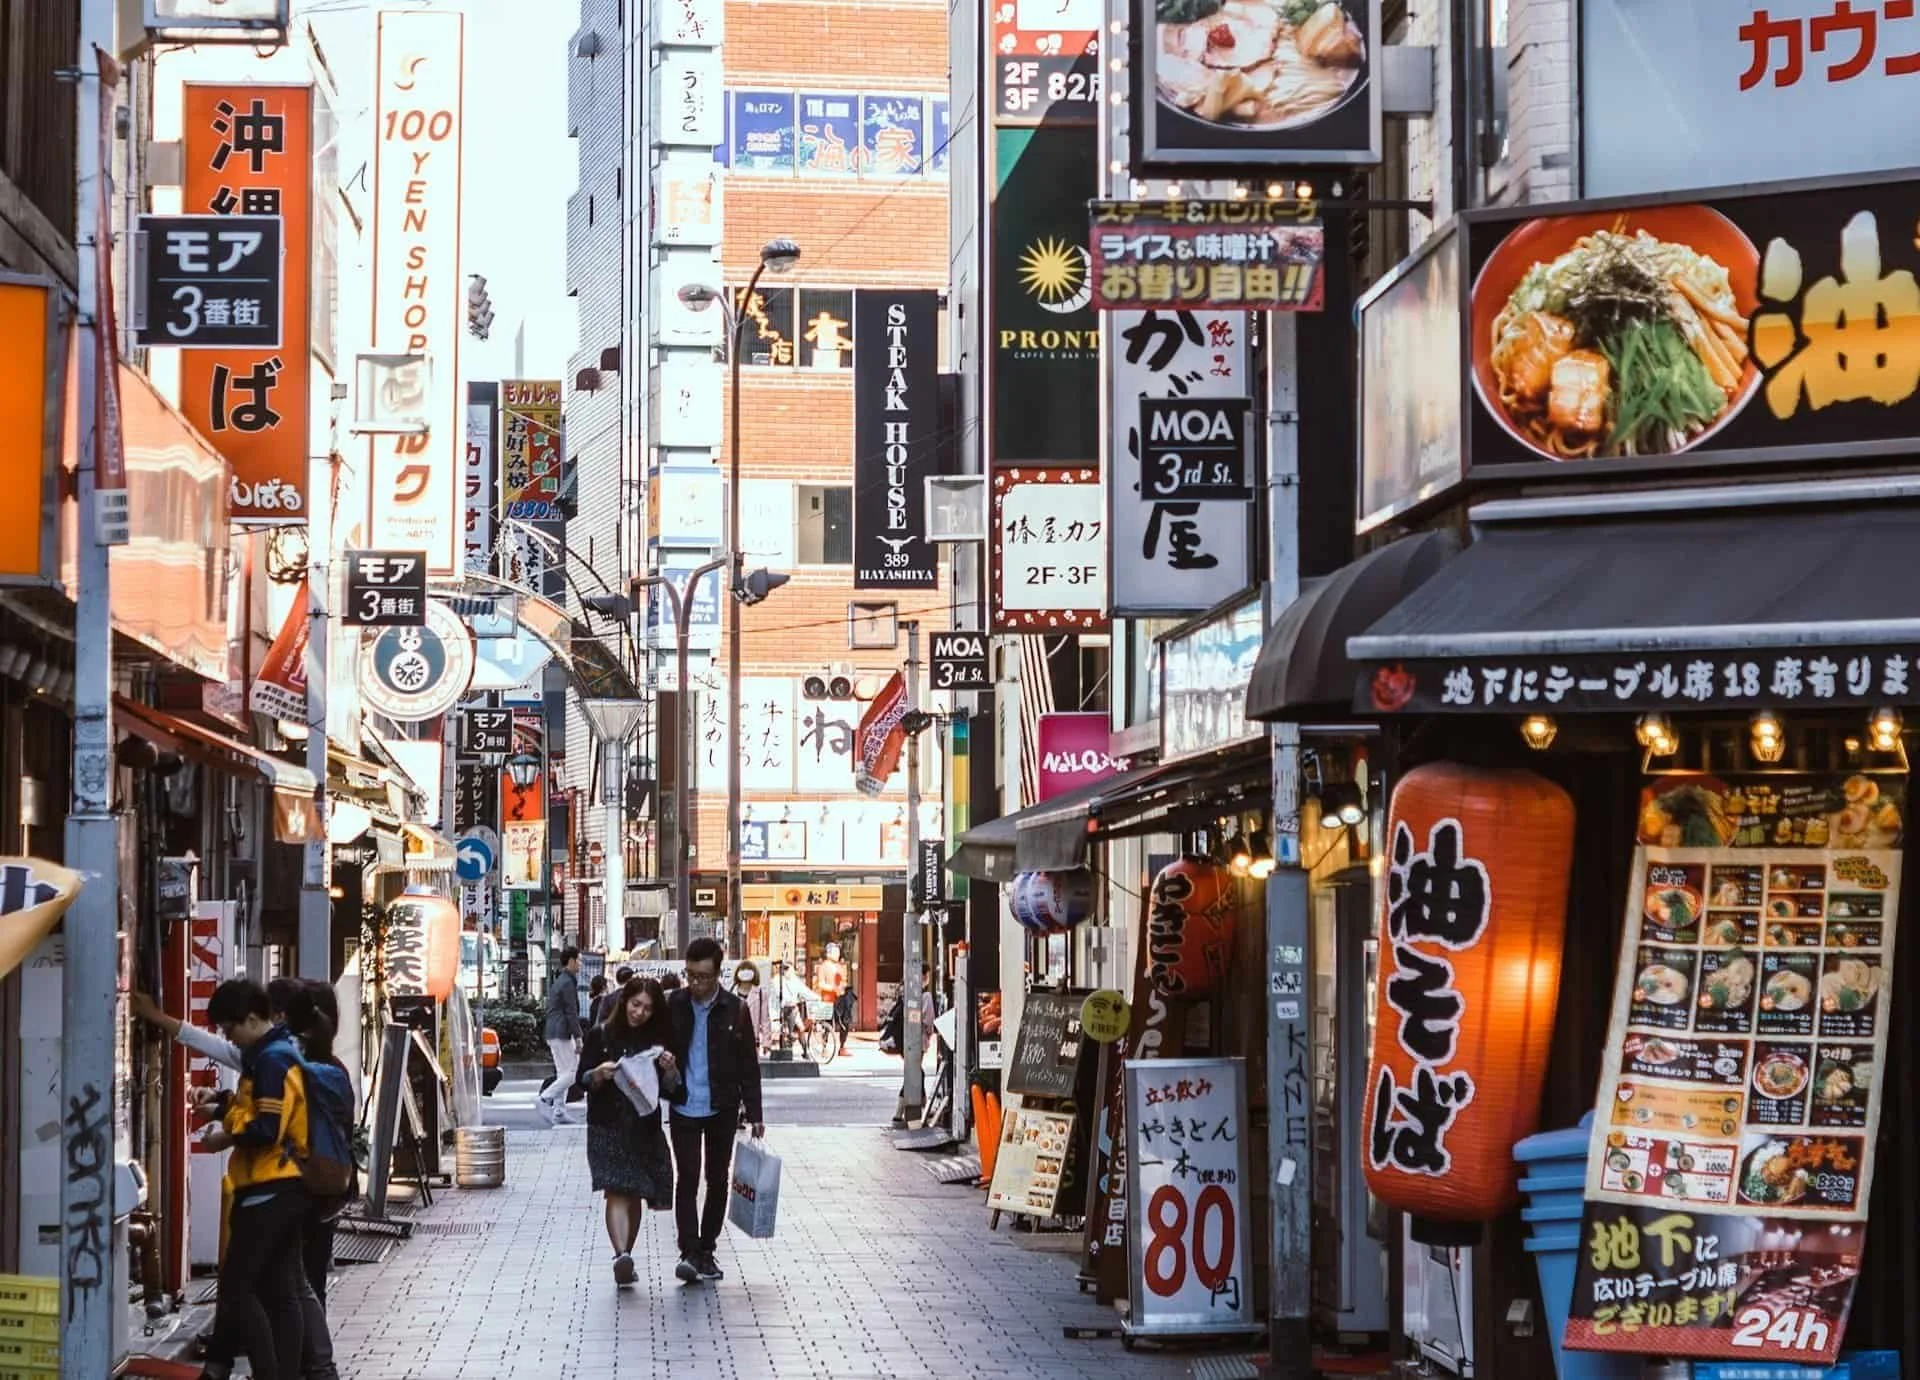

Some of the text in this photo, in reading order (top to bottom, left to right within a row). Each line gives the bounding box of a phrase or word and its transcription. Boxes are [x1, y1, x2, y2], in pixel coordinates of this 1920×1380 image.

[1004, 62, 1040, 84] 2F
[1004, 87, 1040, 110] 3F
[385, 109, 453, 142] 100
[402, 151, 430, 233] YEN
[166, 231, 263, 273] モア
[1101, 263, 1313, 300] お替り自由!!
[166, 286, 262, 338] 3番街
[884, 303, 909, 530] STEAK HOUSE
[1150, 410, 1235, 442] MOA
[1154, 453, 1233, 495] 3rd St.
[358, 557, 417, 583] モア
[859, 570, 934, 581] HAYASHIYA
[883, 553, 909, 567] 389
[359, 589, 415, 621] 3番街
[935, 637, 985, 657] MOA
[938, 663, 985, 688] 3rd St.
[1440, 654, 1920, 705] 地下にテーブル席18席有りま
[473, 712, 507, 729] モア
[806, 889, 840, 905] 松屋
[1368, 818, 1492, 1176] 油そば
[1145, 1079, 1213, 1106] 立ち飲み
[1138, 1116, 1237, 1145] やきとん
[1589, 1213, 1720, 1271] 地下に
[1593, 1261, 1738, 1303] 広いテーブル席
[1592, 1292, 1737, 1337] ございます!
[1731, 1307, 1830, 1351] 24h
